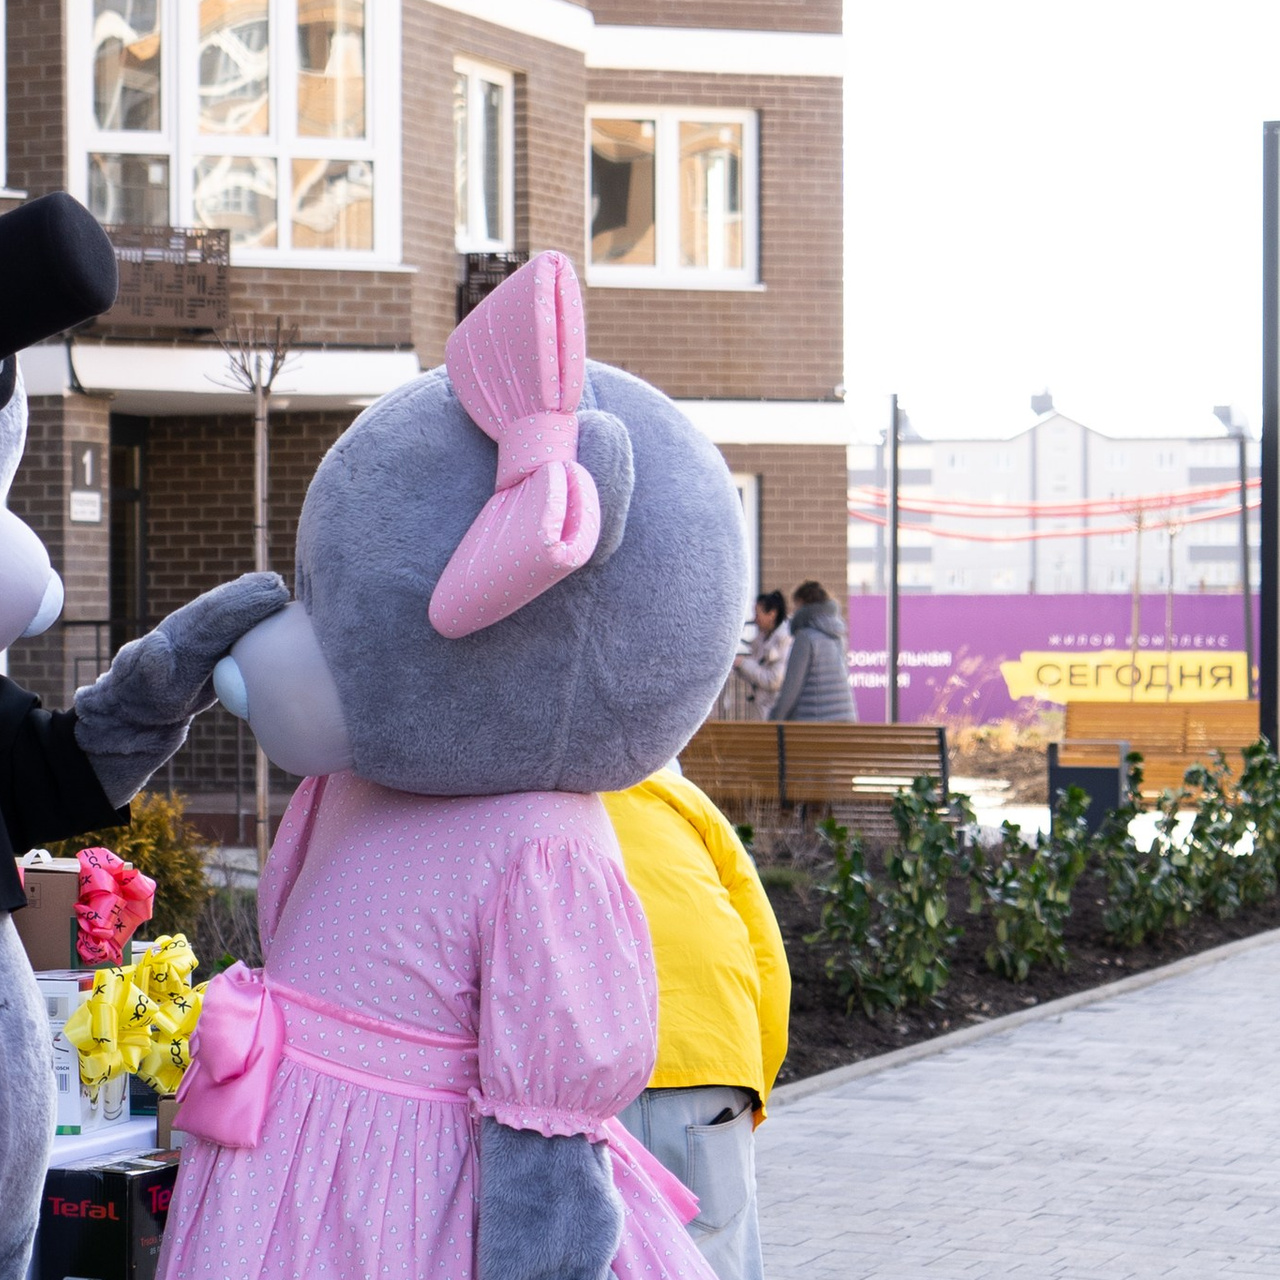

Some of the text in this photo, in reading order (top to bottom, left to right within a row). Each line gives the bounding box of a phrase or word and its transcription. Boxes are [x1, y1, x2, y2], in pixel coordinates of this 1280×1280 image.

[82, 449, 93, 487] 1
[1036, 663, 1233, 692] СЕГОДНЯ
[48, 1196, 120, 1221] Tefal
